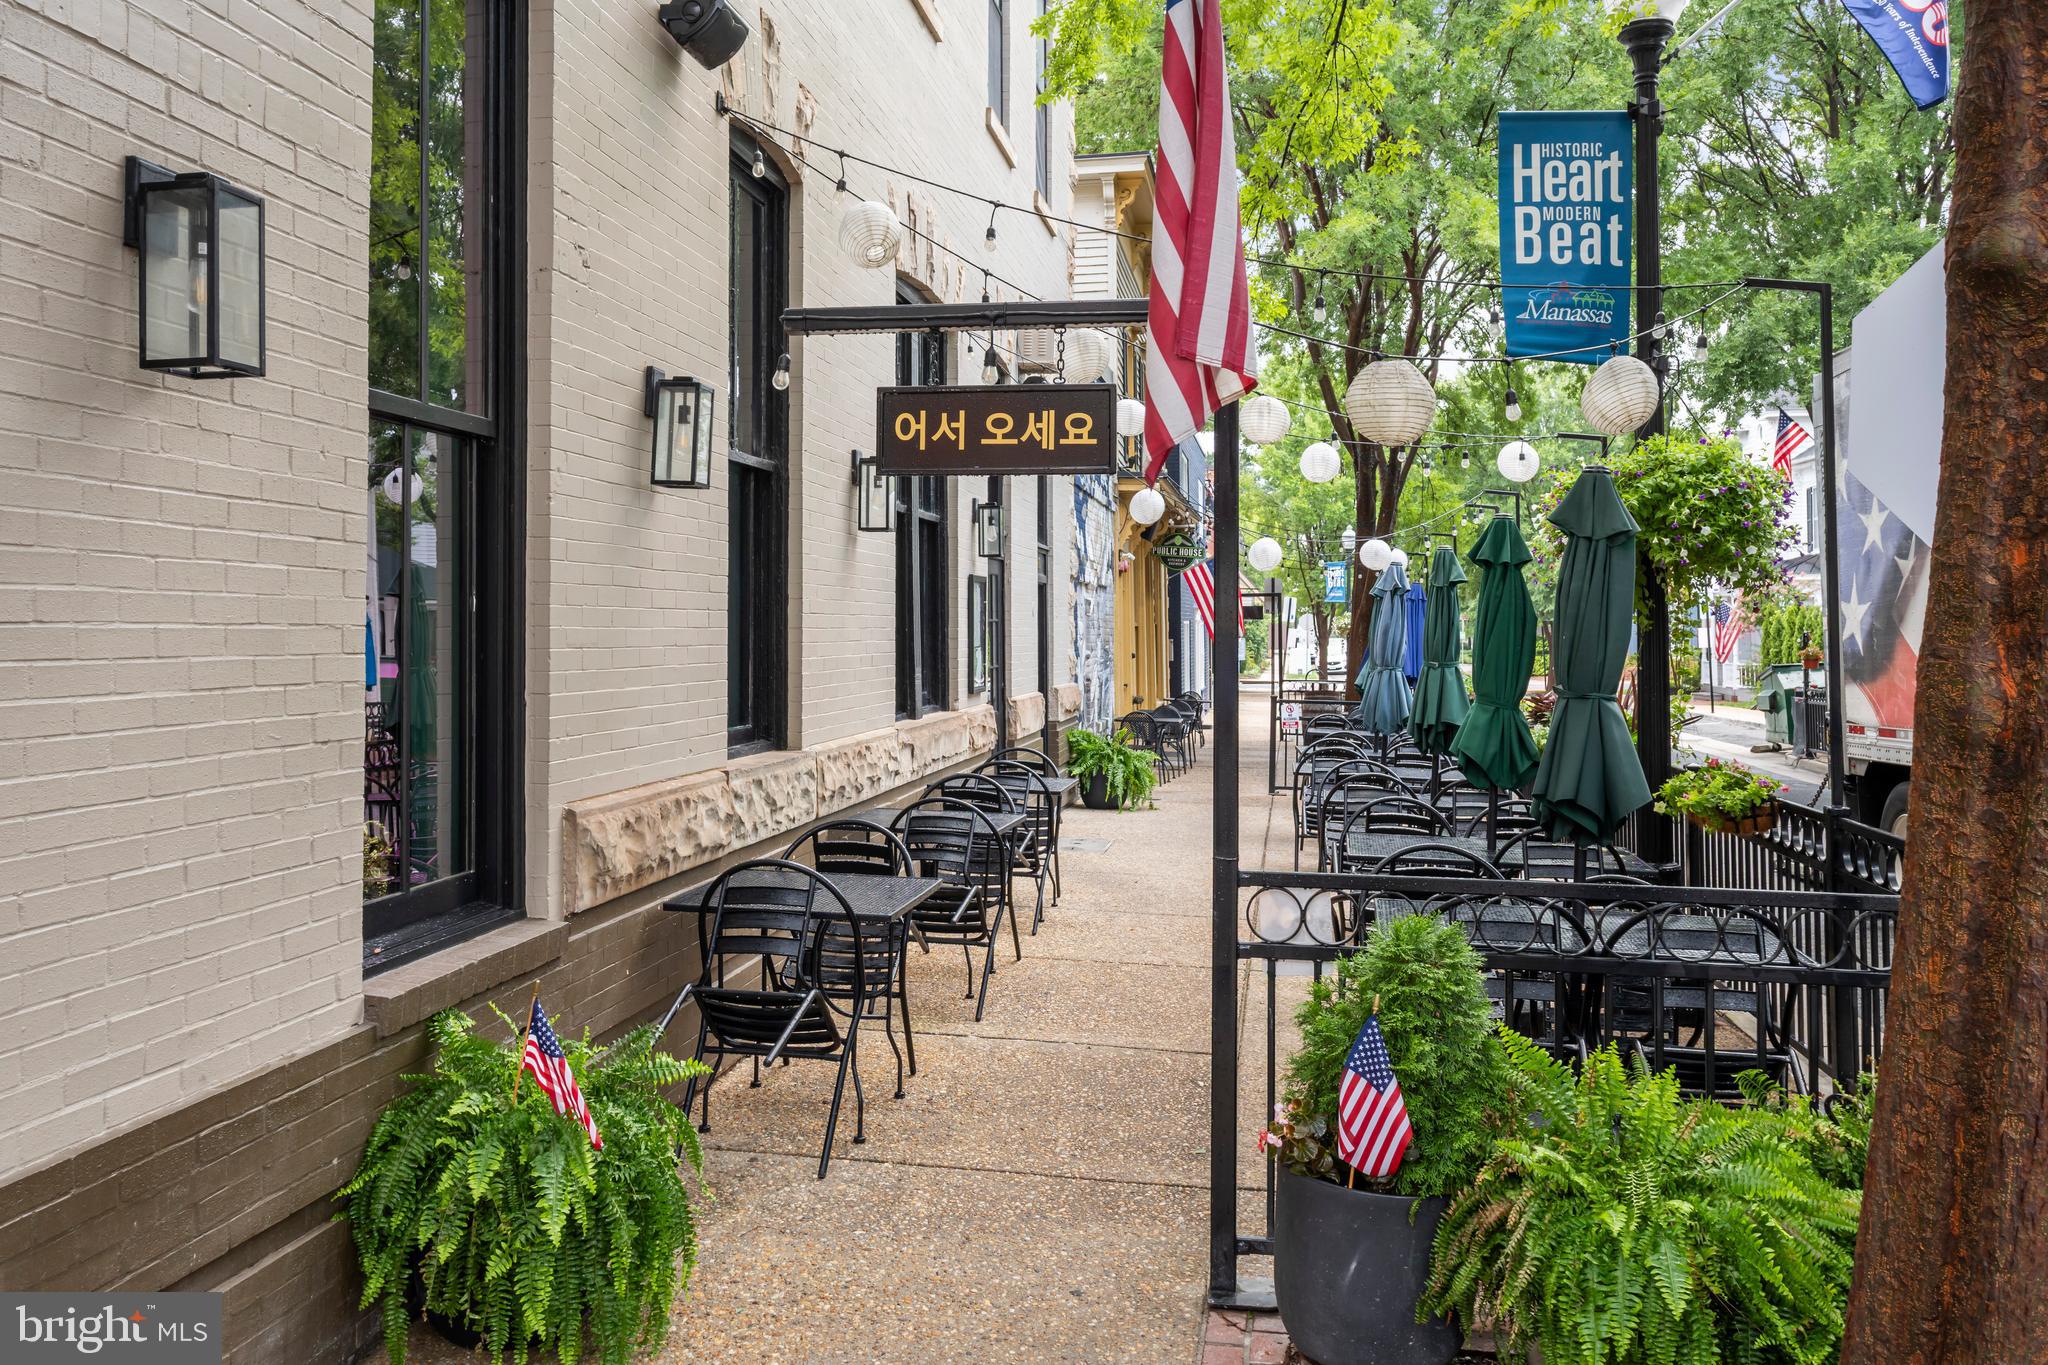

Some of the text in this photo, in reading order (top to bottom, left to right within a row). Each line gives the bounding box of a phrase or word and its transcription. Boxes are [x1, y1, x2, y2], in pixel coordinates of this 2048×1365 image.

[1883, 3, 1902, 21] Years
[1898, 21, 1912, 30] of
[1905, 26, 1940, 79] Independence
[1541, 143, 1603, 158] HISTORIC
[1513, 143, 1624, 203] Heart
[1542, 206, 1601, 222] MODERN
[1515, 206, 1623, 267] Beat
[1517, 299, 1613, 324] Manassas
[894, 409, 1098, 451] 어서 오세요
[1152, 546, 1203, 557] PUBLIC HOUSE
